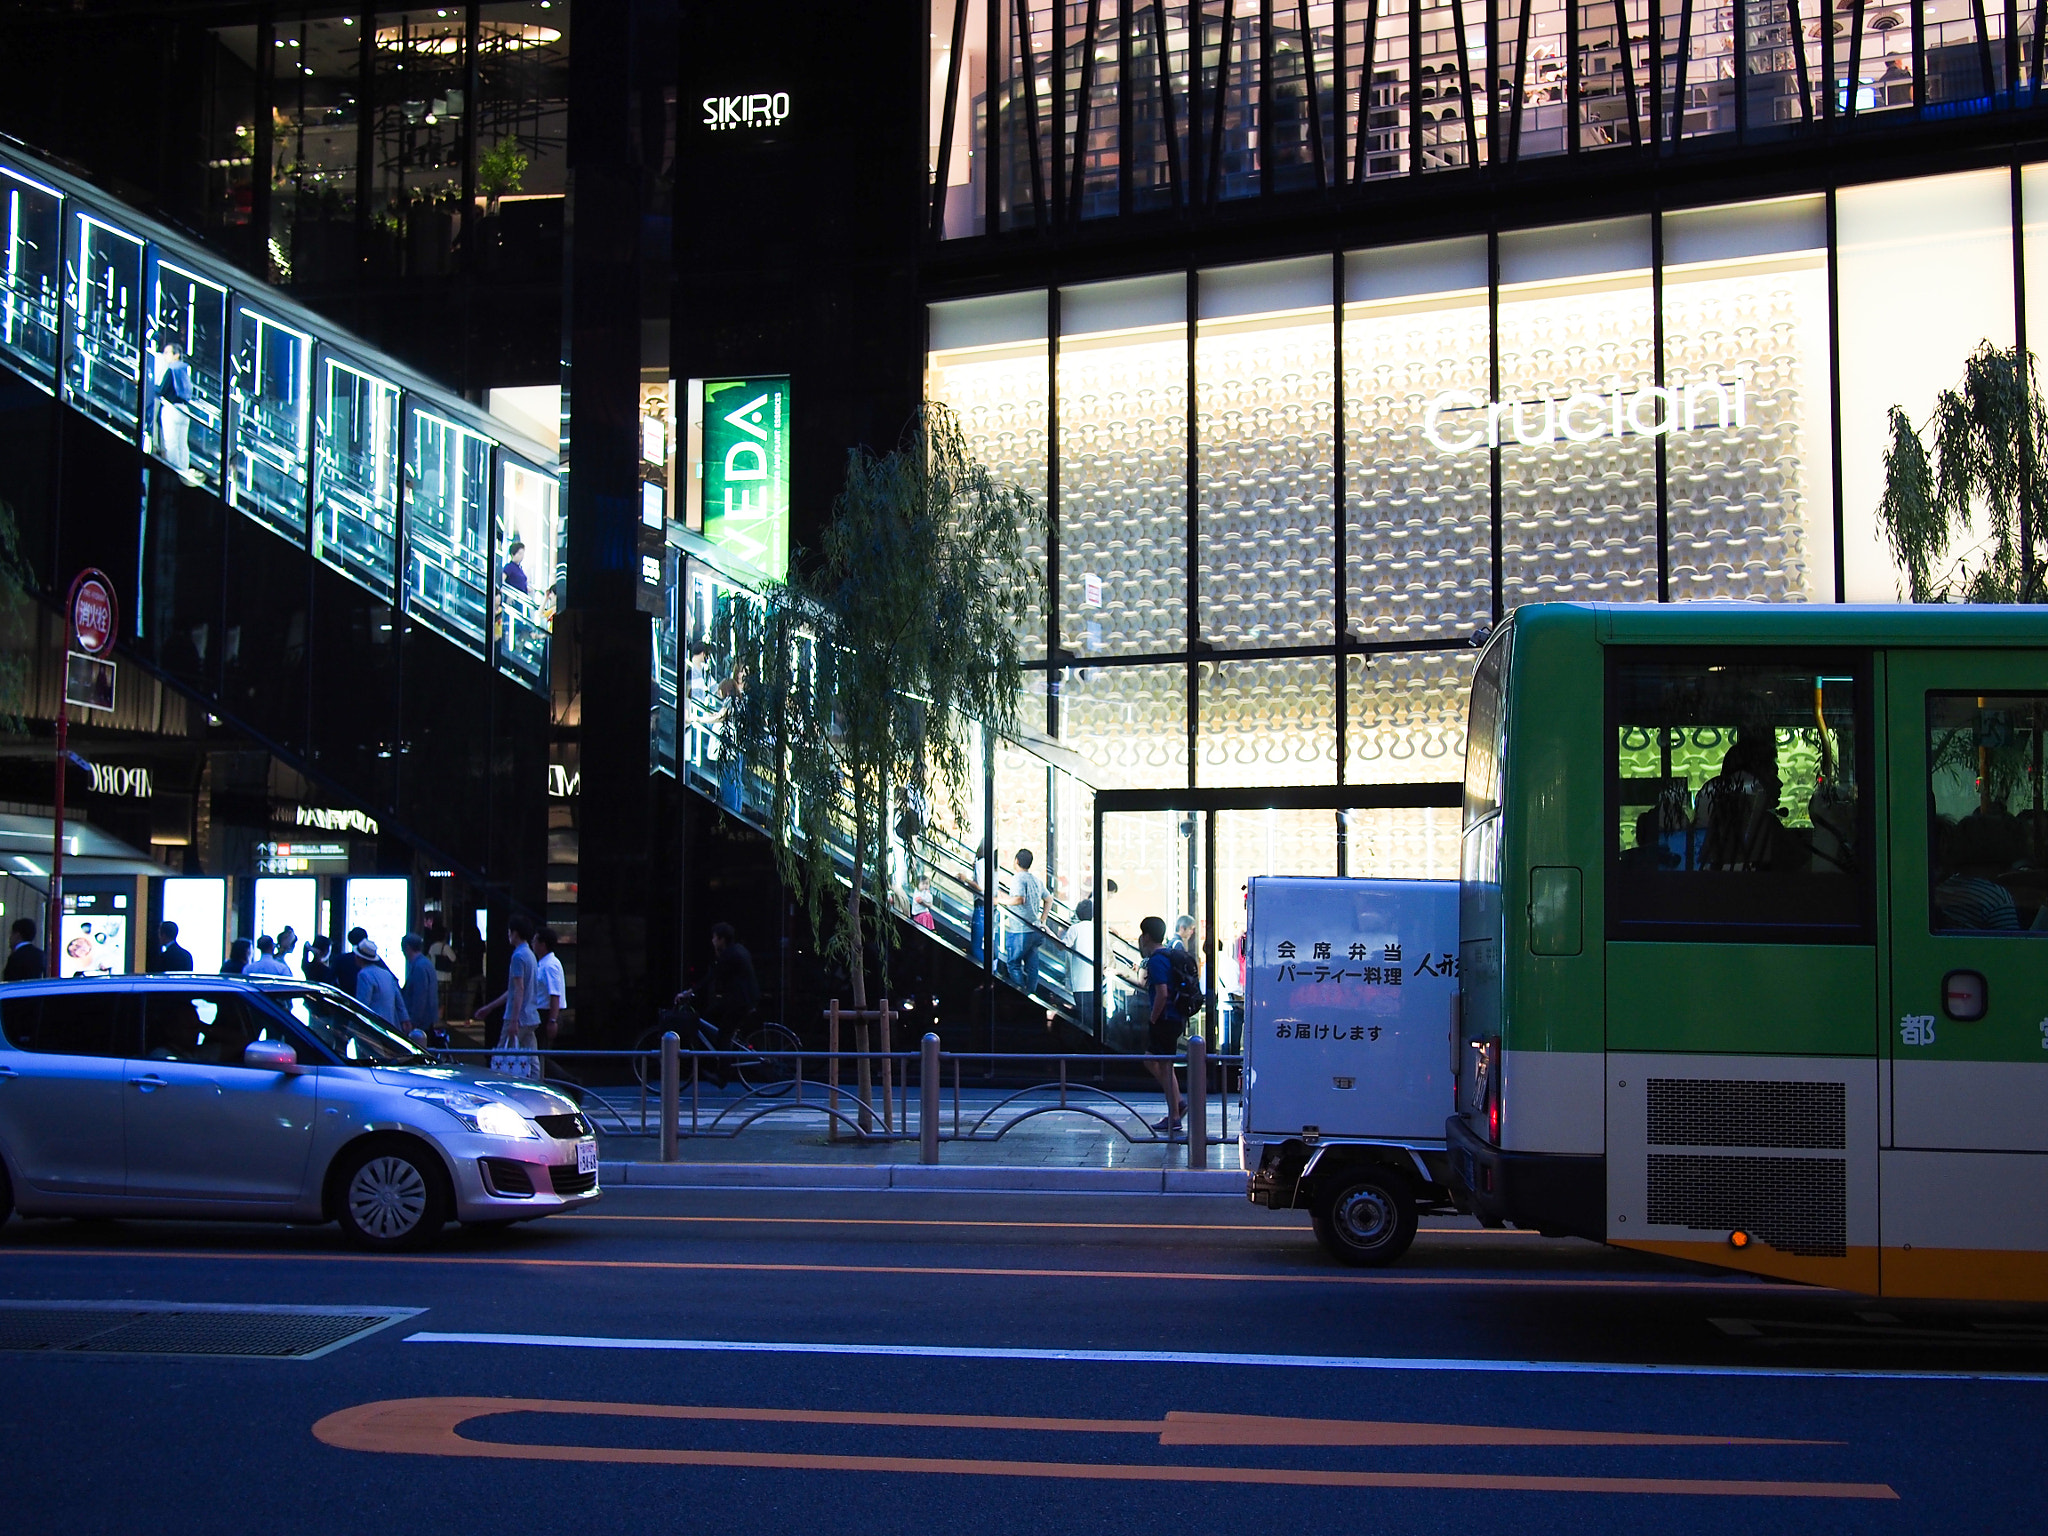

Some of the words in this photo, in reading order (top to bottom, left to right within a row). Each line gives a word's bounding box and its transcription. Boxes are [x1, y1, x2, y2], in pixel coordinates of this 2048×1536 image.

[703, 92, 789, 124] SIKIRO
[1424, 364, 1746, 453] Cruciani
[723, 393, 768, 573] VEDA
[79, 600, 108, 633] 消火栓
[1277, 940, 1402, 962] 会席弁当
[1277, 964, 1402, 986] パーティー料理
[1276, 1023, 1382, 1041] お届けします
